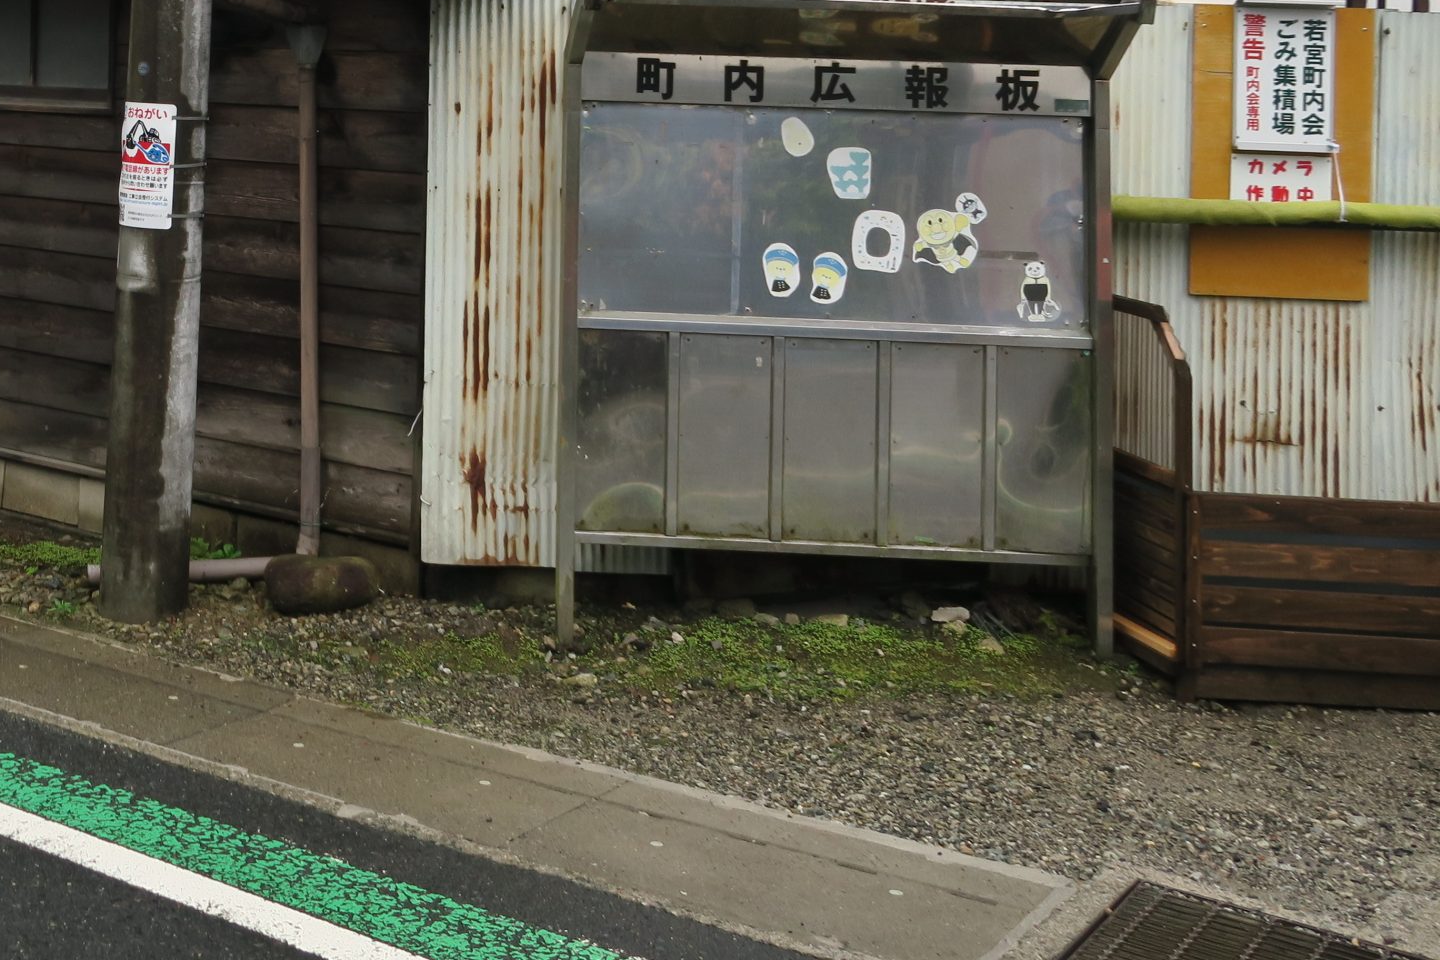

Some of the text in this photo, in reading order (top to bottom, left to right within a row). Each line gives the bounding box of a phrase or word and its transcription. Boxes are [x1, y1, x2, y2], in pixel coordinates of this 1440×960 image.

[636, 57, 1040, 111] 町内広報板
[1242, 13, 1266, 131] 警告 町内会専用
[1272, 19, 1299, 136] ごみ集積場
[1301, 19, 1327, 136] 若宮町内会
[127, 107, 168, 120] おねがい
[1246, 185, 1314, 202] 作動中
[1247, 159, 1313, 176] カメラ
